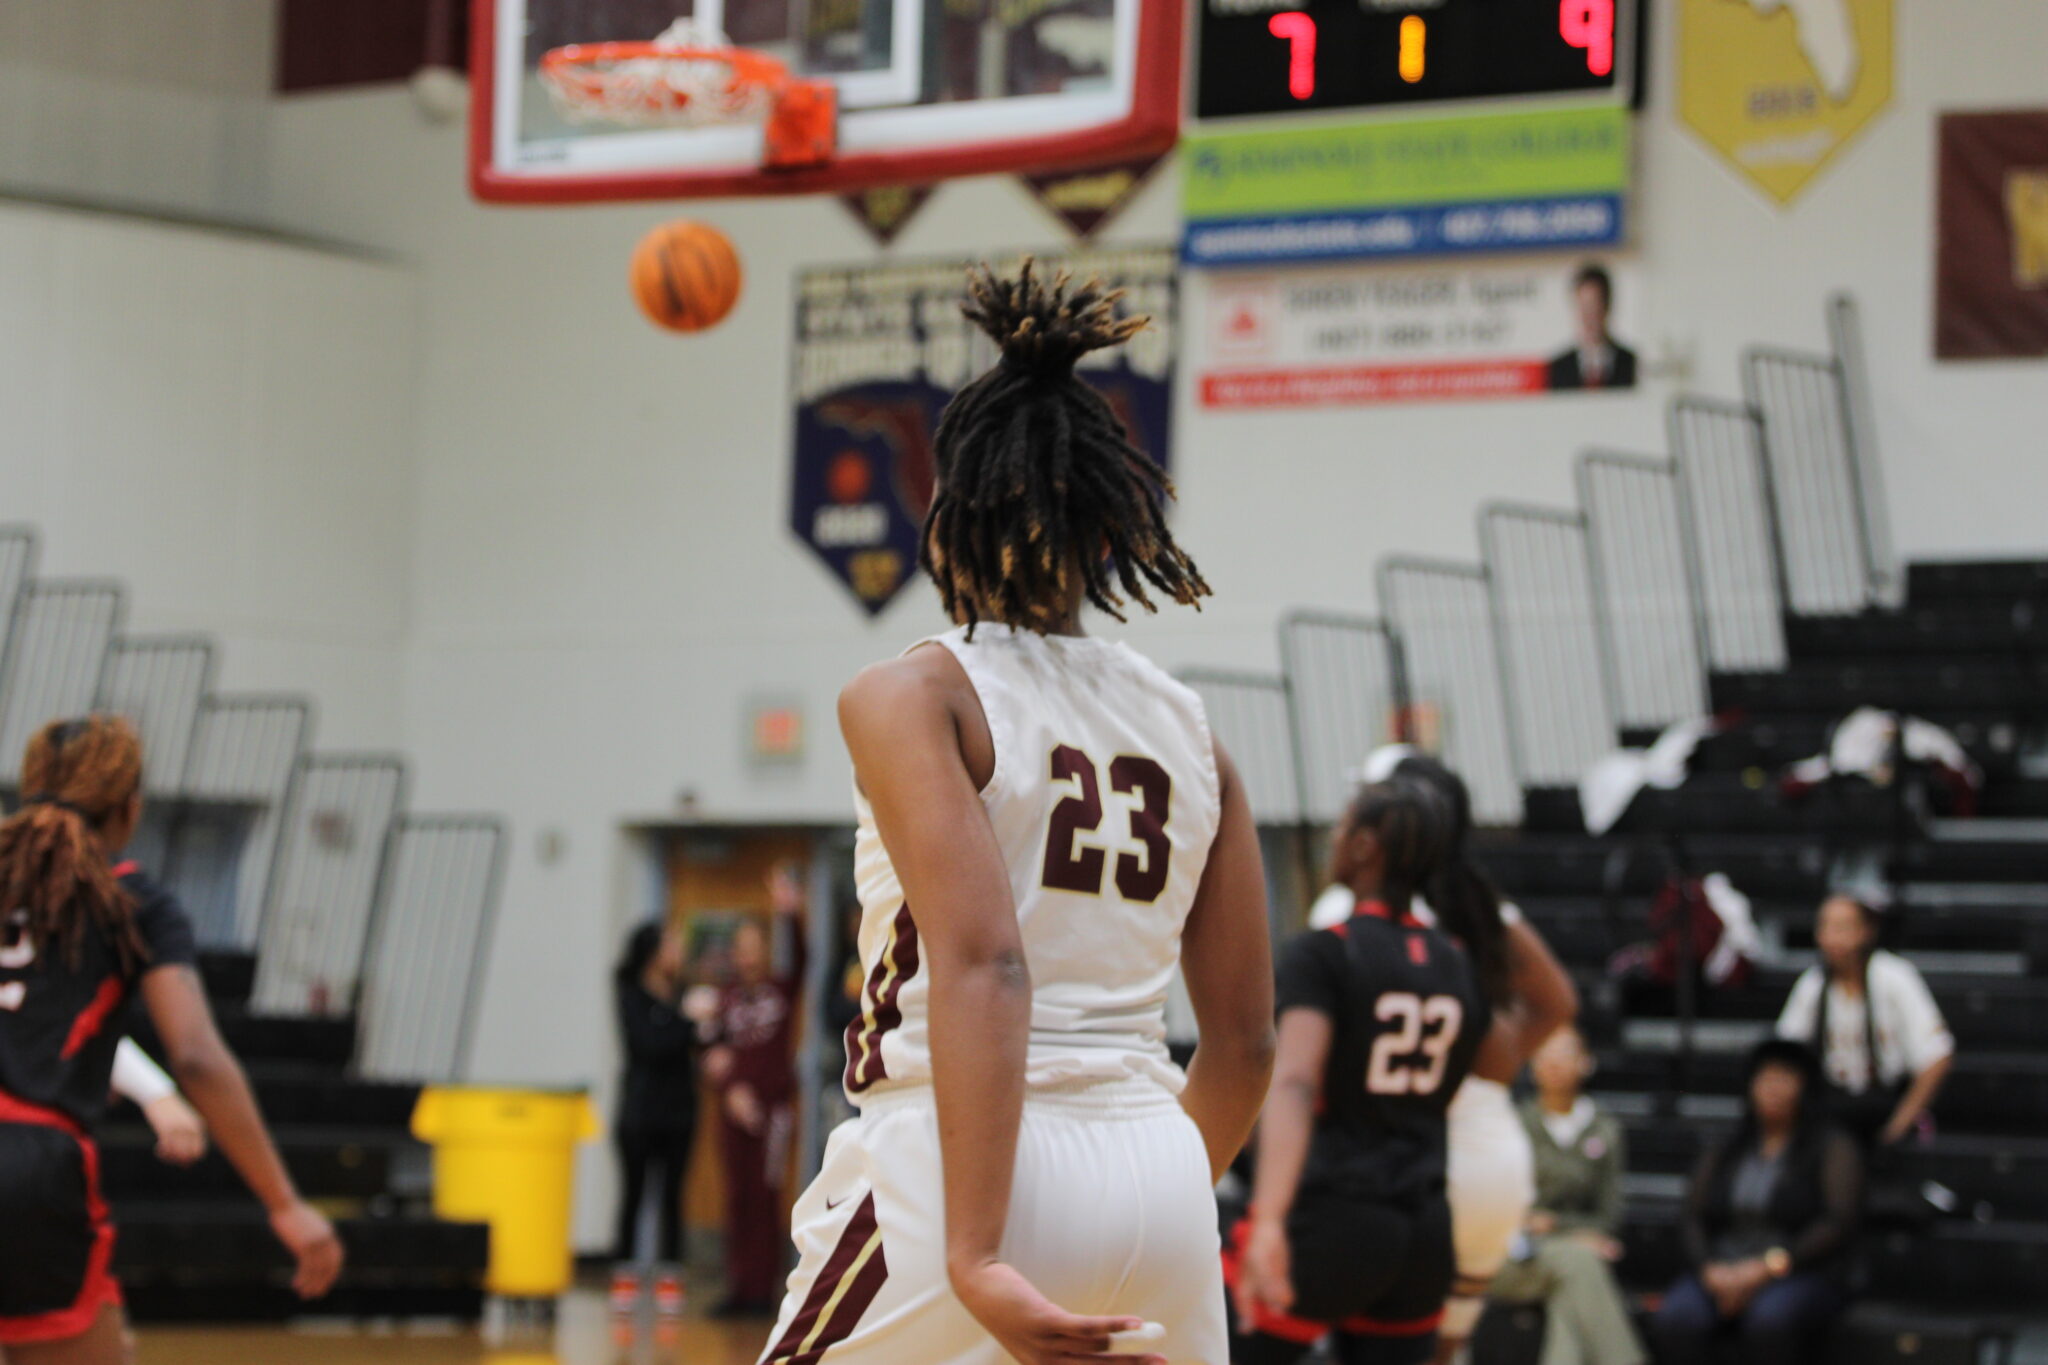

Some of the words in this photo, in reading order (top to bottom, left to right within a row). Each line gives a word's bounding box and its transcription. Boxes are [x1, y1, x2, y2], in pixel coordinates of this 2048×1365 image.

[1268, 12, 1316, 100] 7
[1399, 15, 1425, 83] 1
[1559, 0, 1614, 76] 9
[1040, 742, 1173, 905] 23
[1365, 991, 1464, 1094] 23
